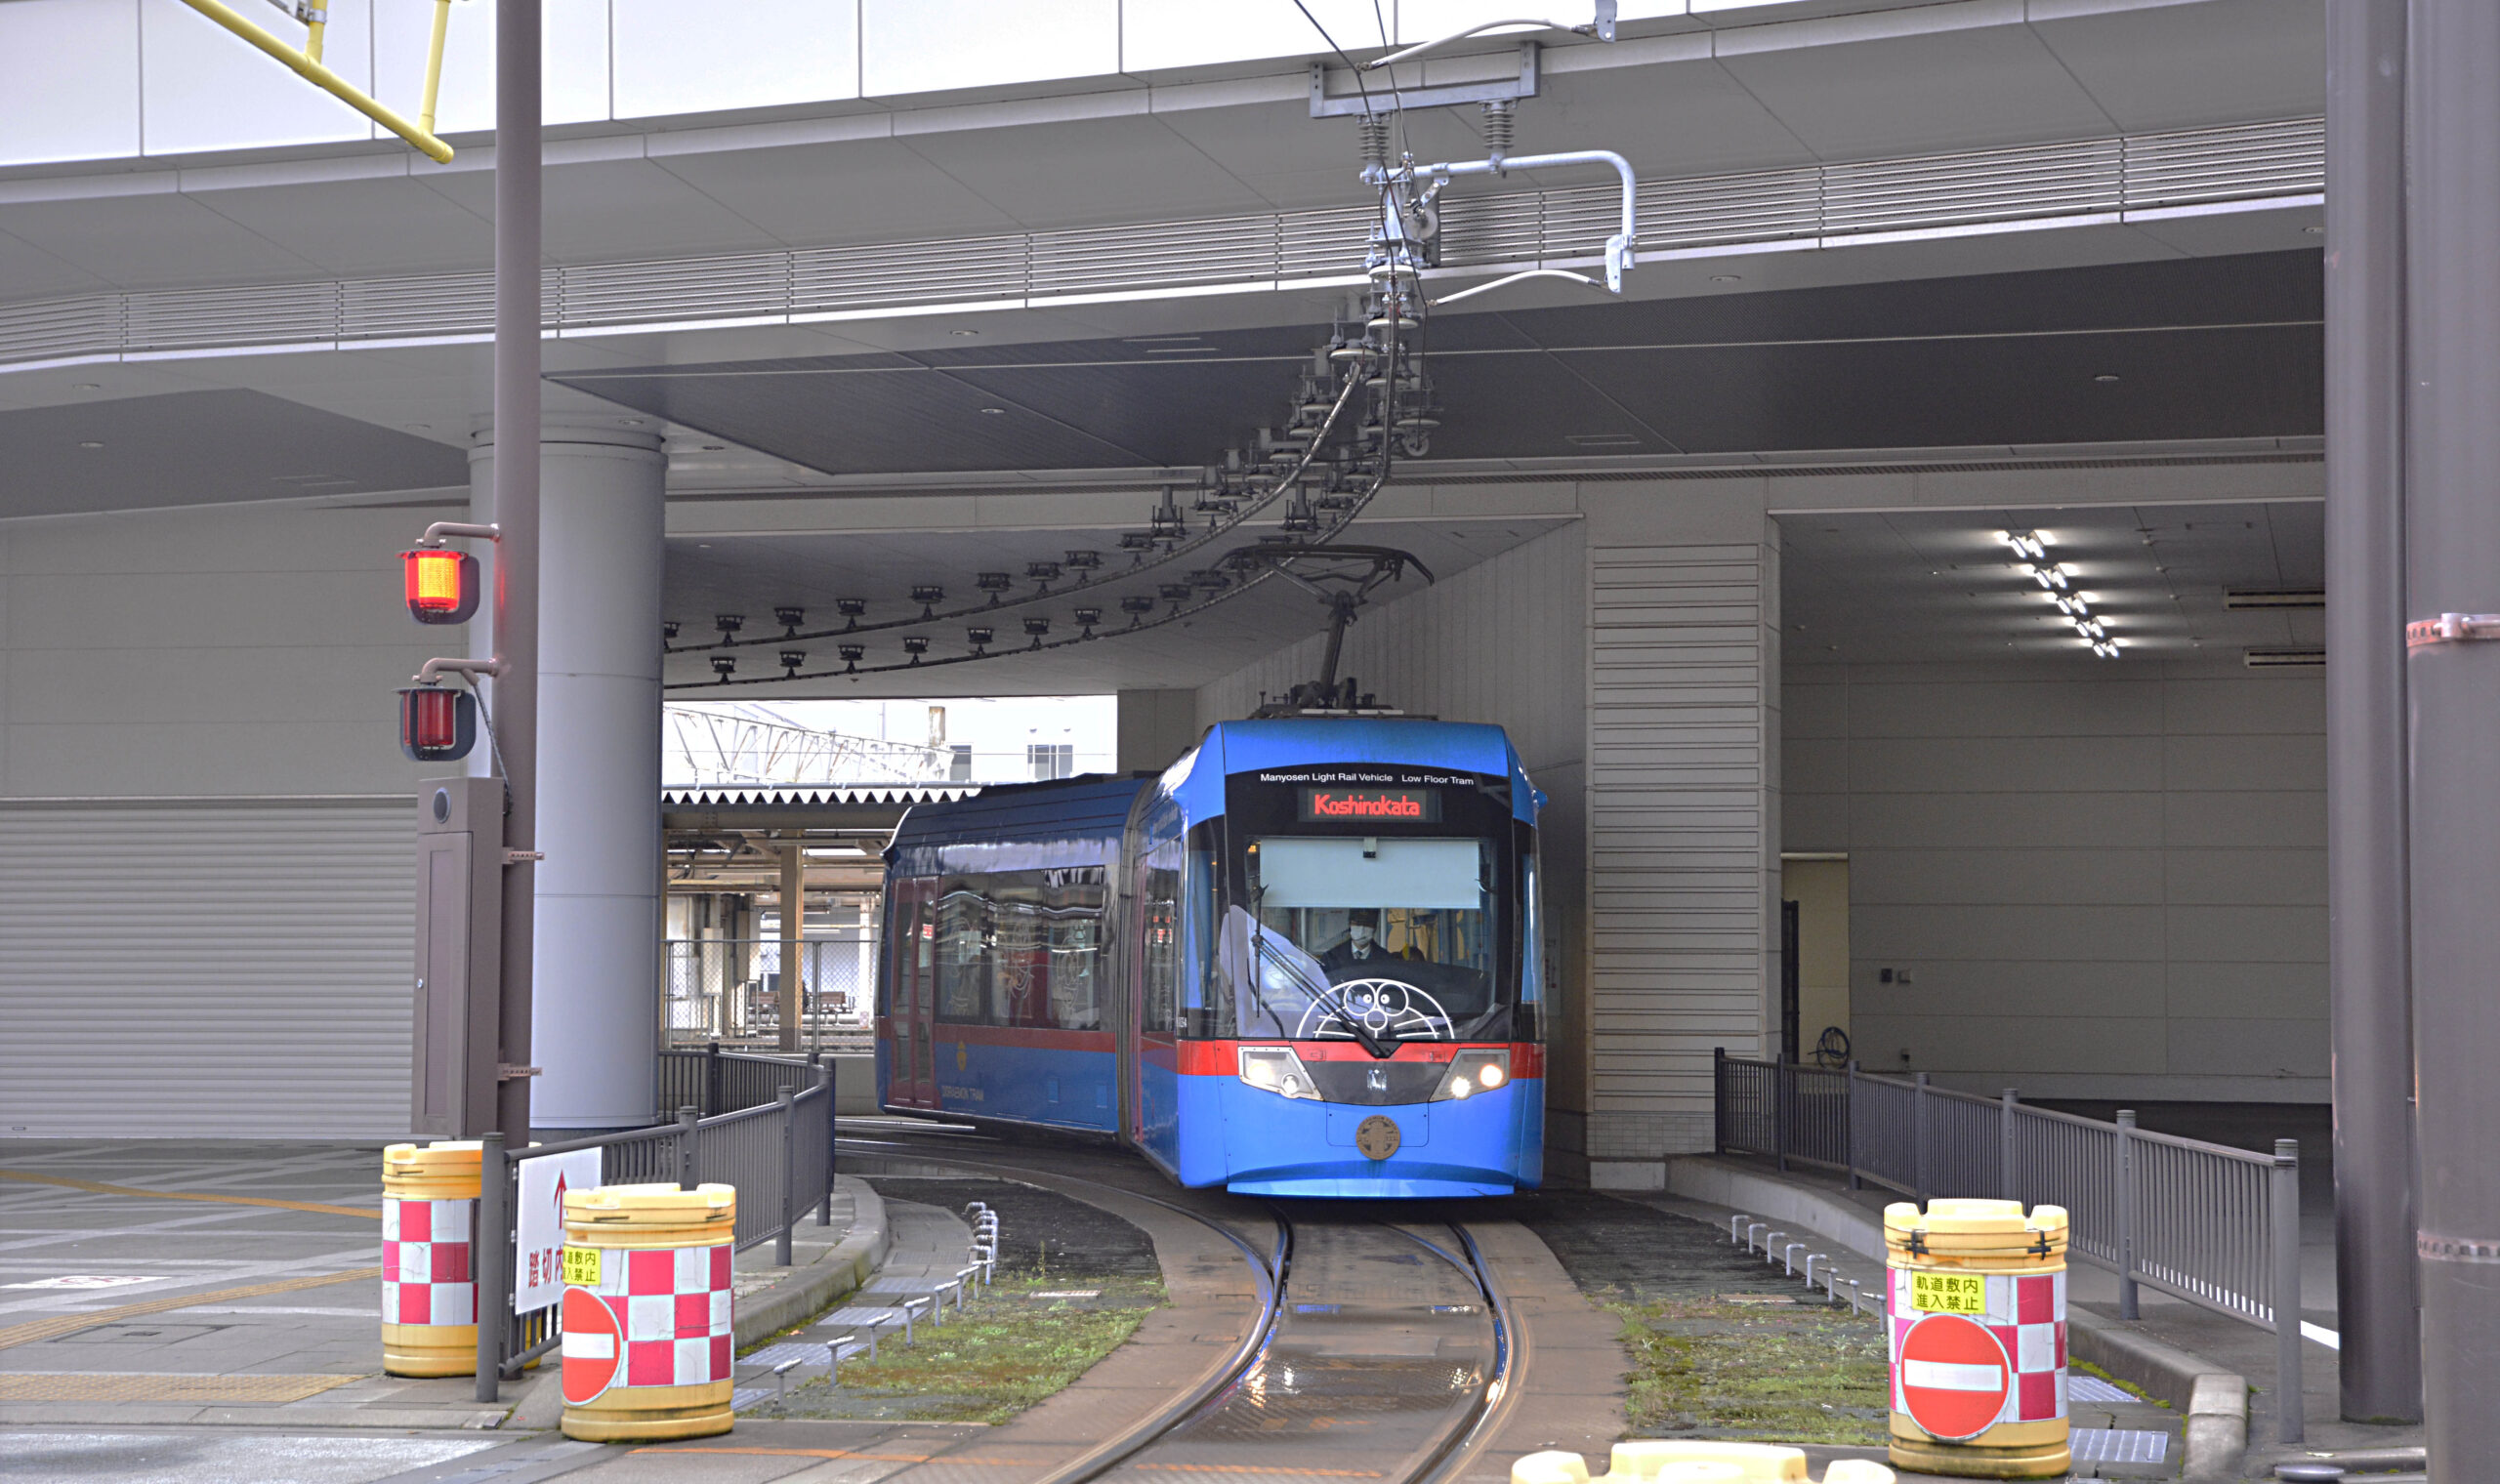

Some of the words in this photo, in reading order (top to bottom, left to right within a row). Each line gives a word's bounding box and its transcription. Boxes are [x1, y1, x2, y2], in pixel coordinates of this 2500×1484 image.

[1260, 773, 1310, 783] Manyosen
[1312, 773, 1336, 783] Light
[1358, 773, 1394, 782] Vehicle
[1424, 774, 1448, 784] Floor
[1449, 776, 1475, 786] Tram
[1314, 794, 1421, 816] Koshinokata
[1916, 1275, 1979, 1294] 軌道敷内
[1916, 1293, 1979, 1311] 進入禁止
